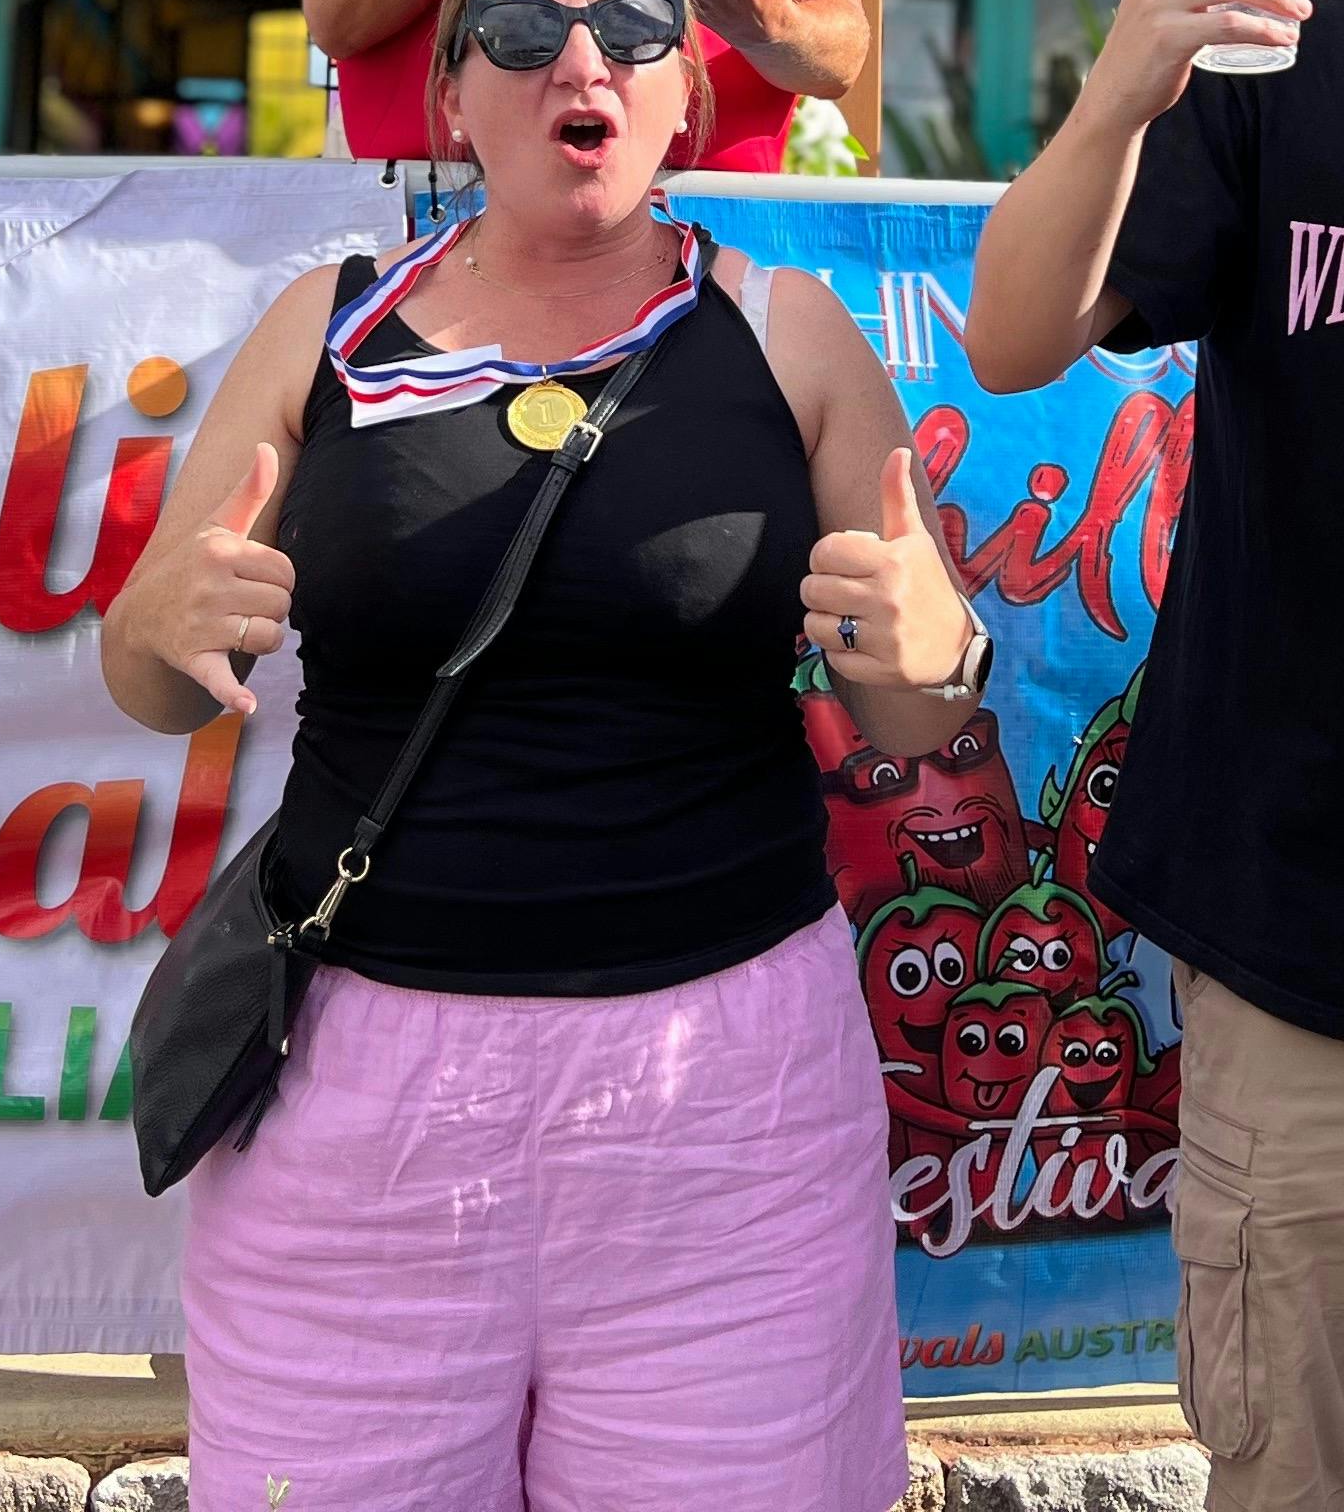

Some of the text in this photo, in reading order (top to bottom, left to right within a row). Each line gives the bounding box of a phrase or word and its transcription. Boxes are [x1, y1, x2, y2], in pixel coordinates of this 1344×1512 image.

[881, 1062, 1181, 1257] estiva
[898, 1318, 1176, 1369] vals AUSTR
